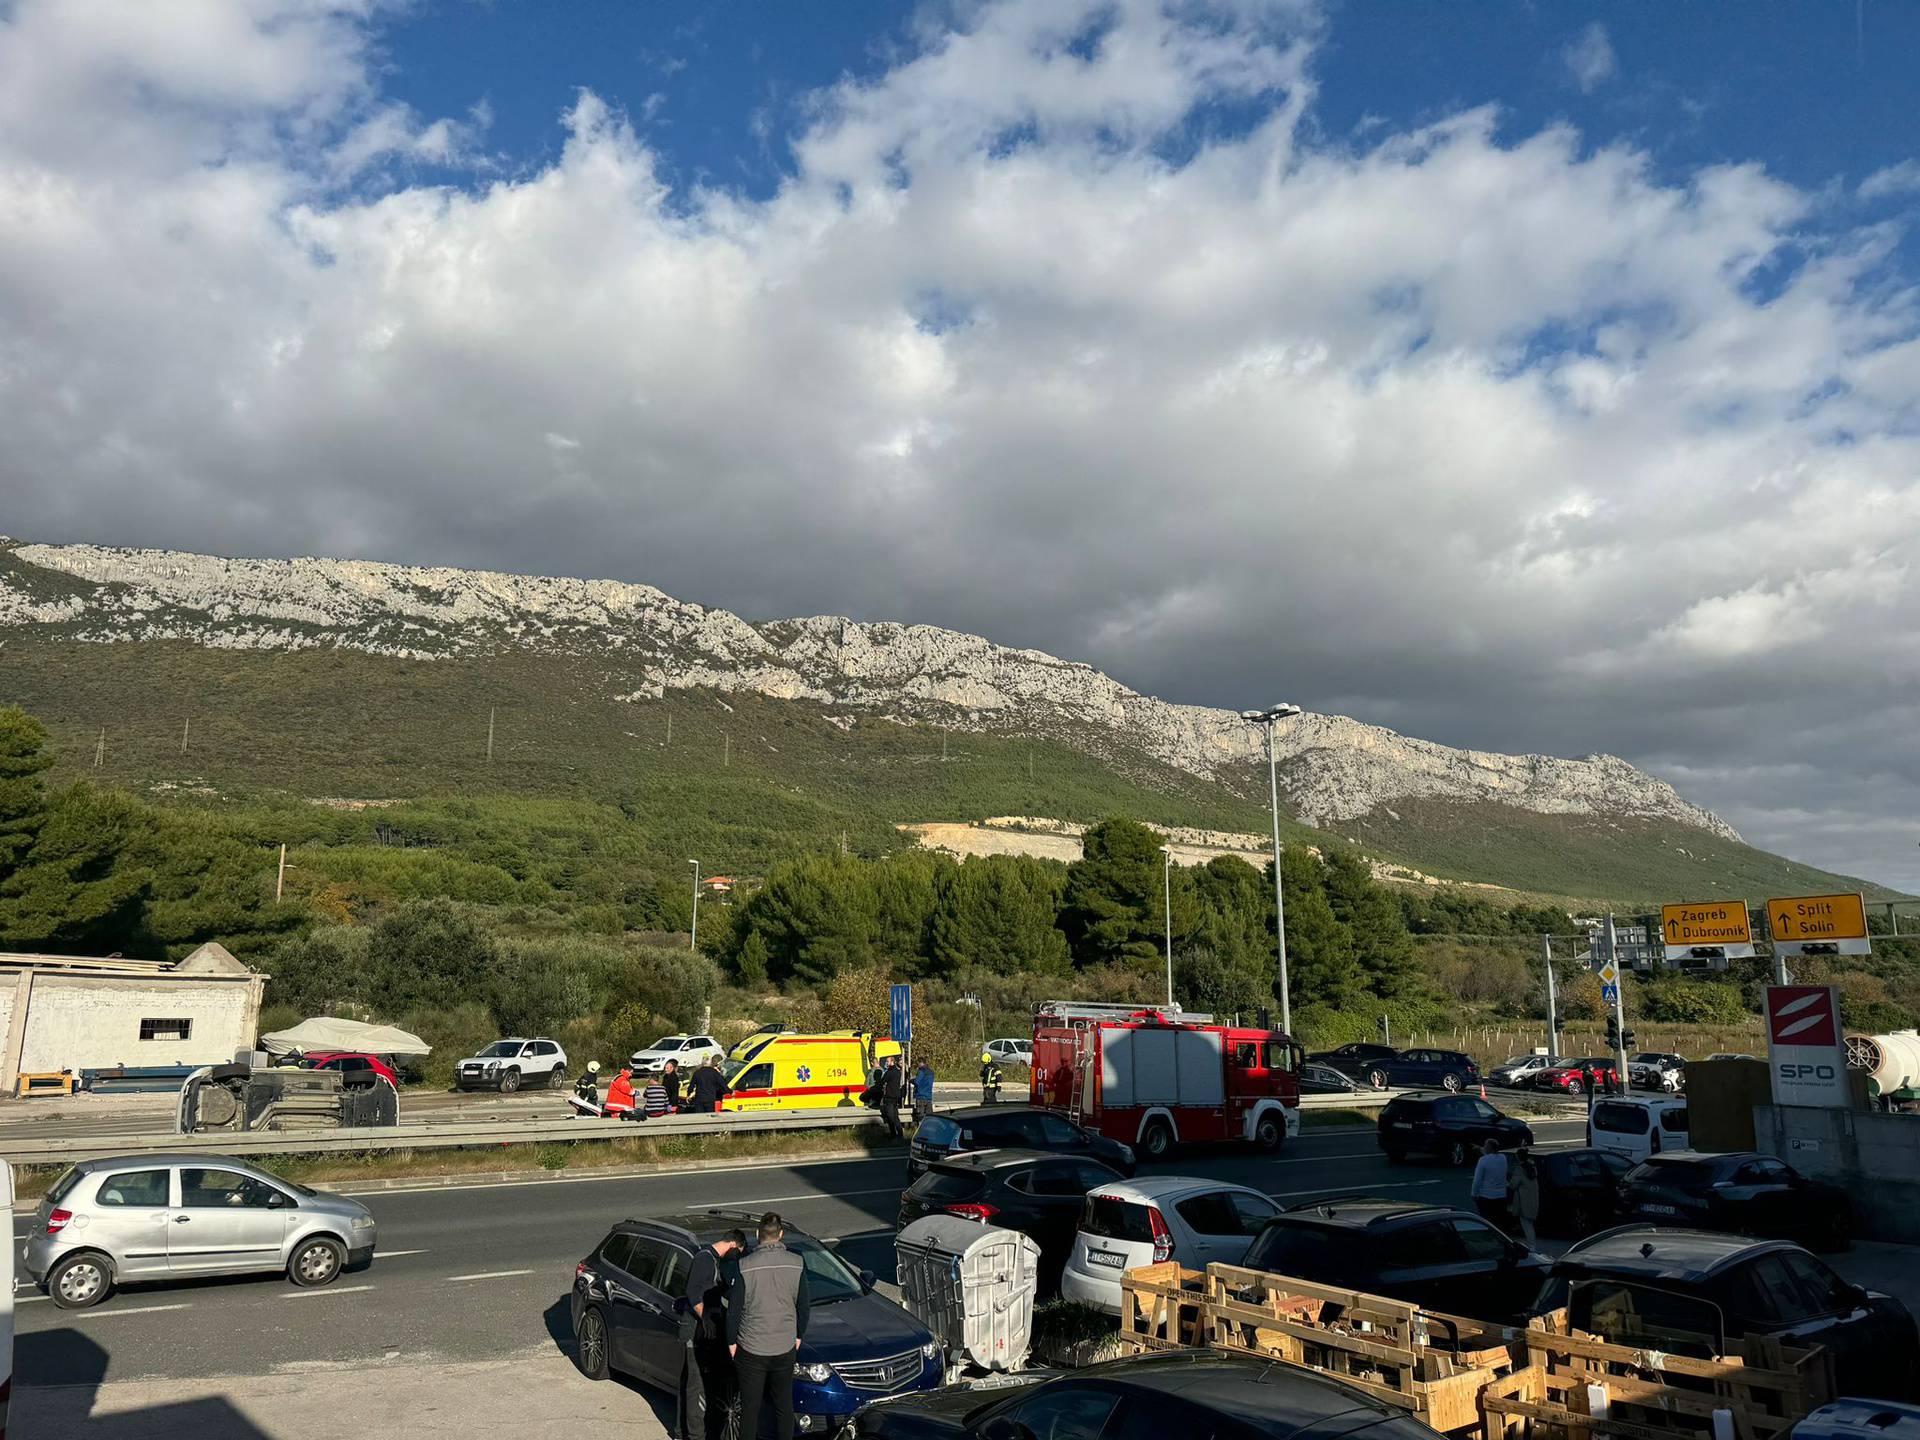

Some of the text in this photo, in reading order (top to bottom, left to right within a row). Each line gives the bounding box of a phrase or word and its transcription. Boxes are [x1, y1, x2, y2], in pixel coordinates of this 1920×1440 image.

[1681, 909, 1727, 923] Zagreb
[1797, 903, 1832, 918] Split
[1683, 925, 1745, 938] Dubrovnik
[1799, 921, 1835, 933] Solin
[832, 1069, 847, 1078] 194
[1780, 1064, 1834, 1079] SPO
[1167, 1287, 1185, 1298] OPEN
[1186, 1291, 1202, 1302] THIS
